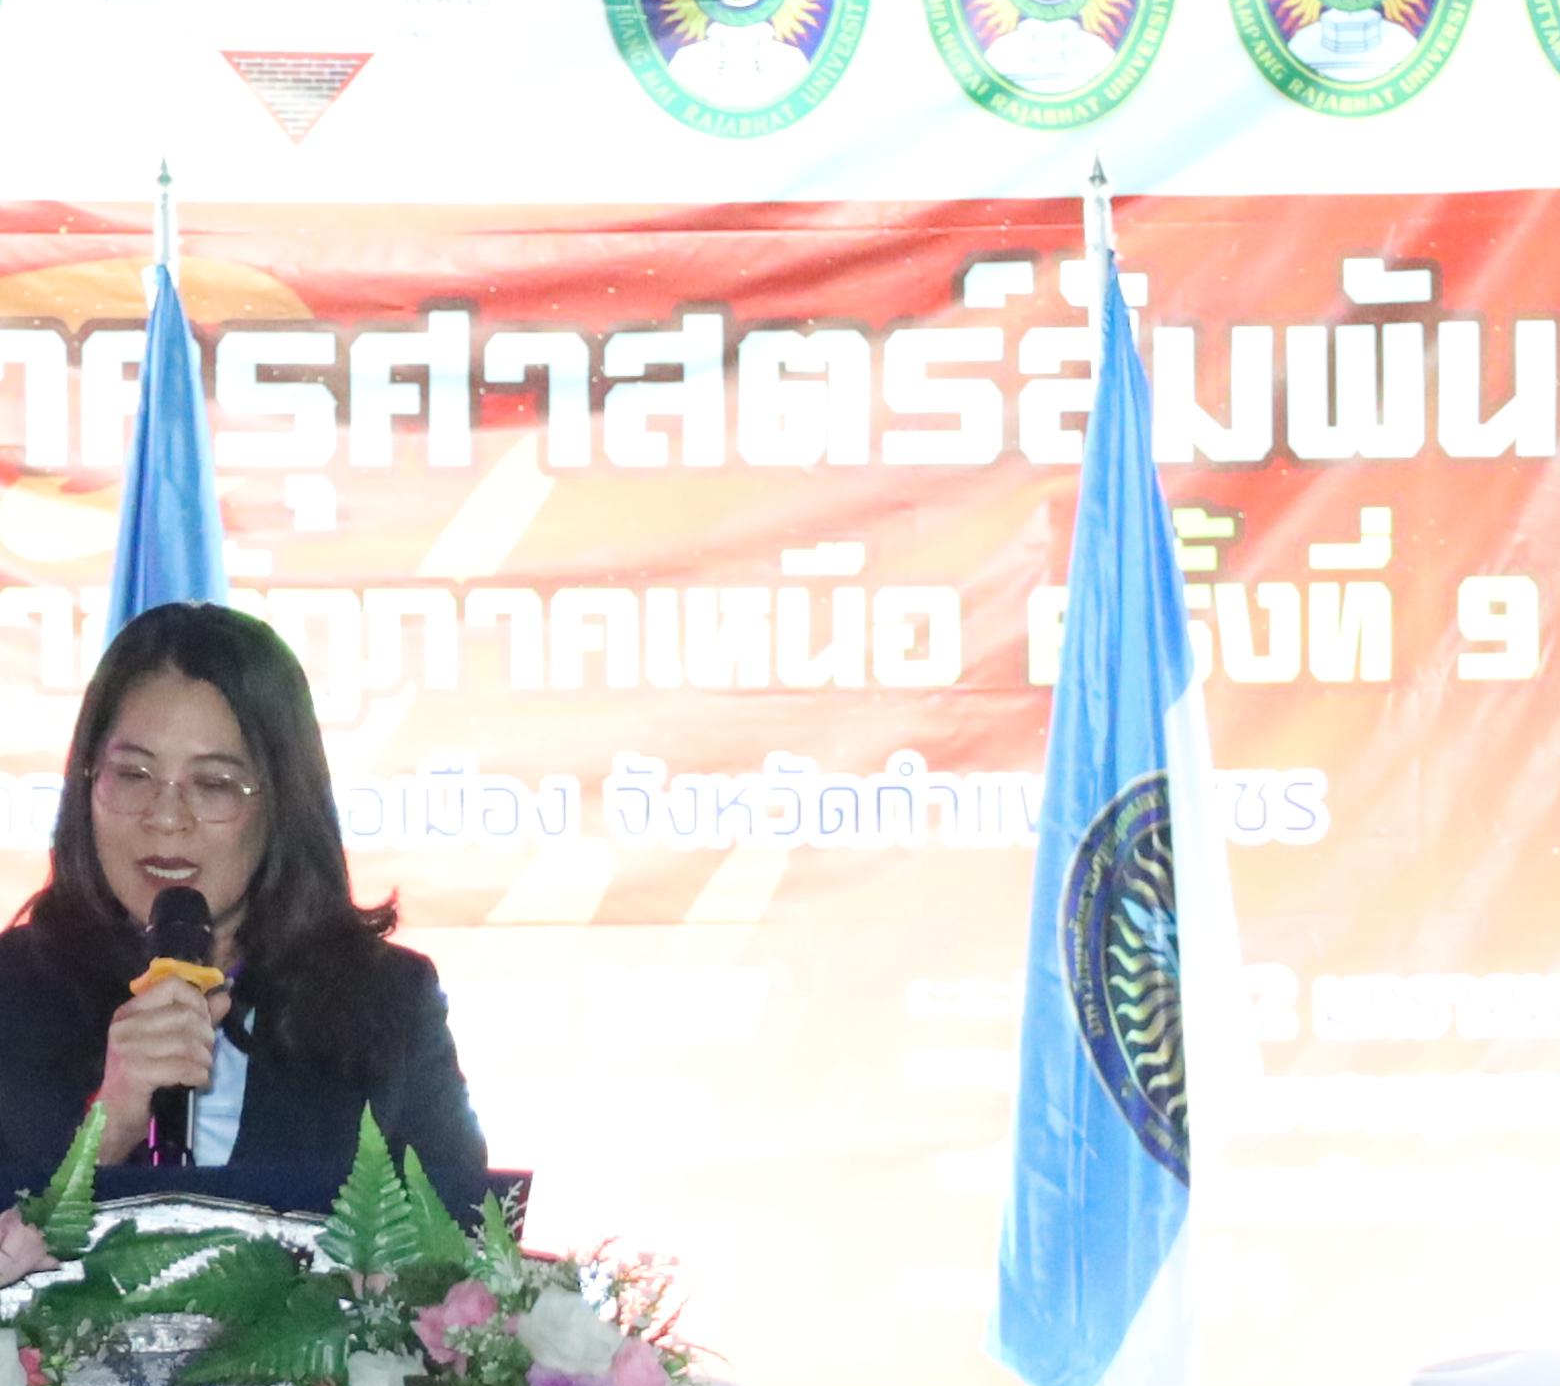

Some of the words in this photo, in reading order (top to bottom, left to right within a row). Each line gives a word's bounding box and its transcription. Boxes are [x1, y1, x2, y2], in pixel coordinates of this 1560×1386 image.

[636, 59, 683, 111] MAI
[678, 93, 799, 138] RAJABHAT
[984, 84, 1105, 131] RAJABHAT
[1282, 71, 1399, 120] RAJABHAT
[1028, 506, 1393, 685] ั้งที่
[1456, 574, 1542, 681] 9
